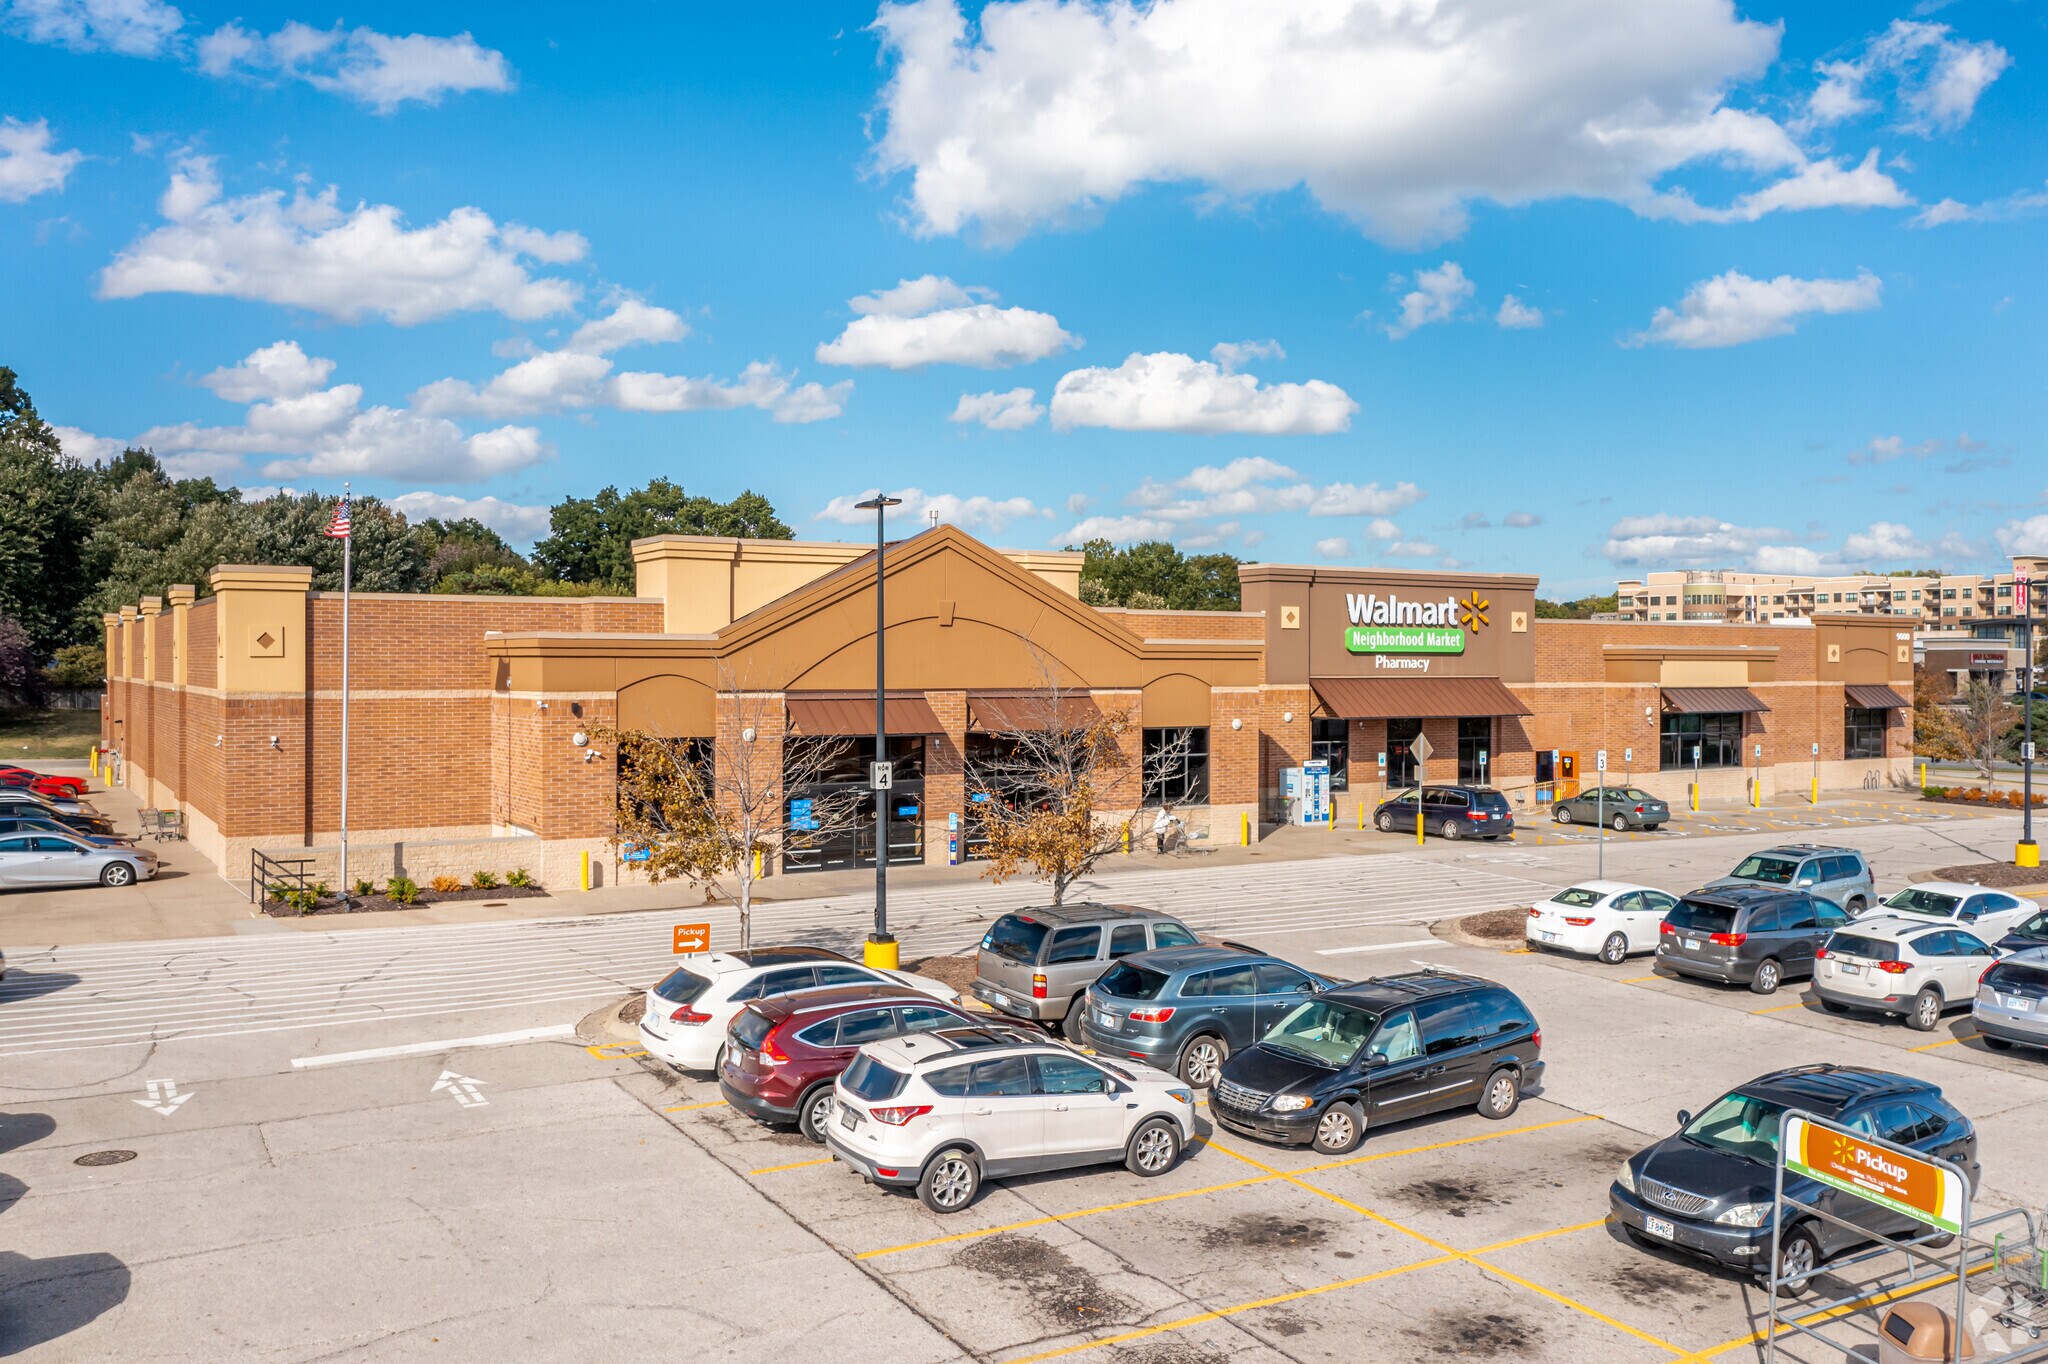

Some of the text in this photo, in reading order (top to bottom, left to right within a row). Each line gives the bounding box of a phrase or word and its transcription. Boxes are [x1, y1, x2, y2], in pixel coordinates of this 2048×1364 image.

[1345, 593, 1459, 626] Walmart
[1353, 631, 1461, 649] Neighborhood Market
[1375, 655, 1430, 673] Pharmacy
[1599, 759, 1605, 769] 3
[879, 773, 888, 786] 4
[677, 928, 706, 937] Pickup
[1856, 1148, 1908, 1183] Pickup
[1807, 1167, 1817, 1176] We
[1825, 1174, 1834, 1183] not
[1834, 1178, 1863, 1194] responsible
[1863, 1188, 1871, 1197] for
[1871, 1192, 1893, 1206] damage
